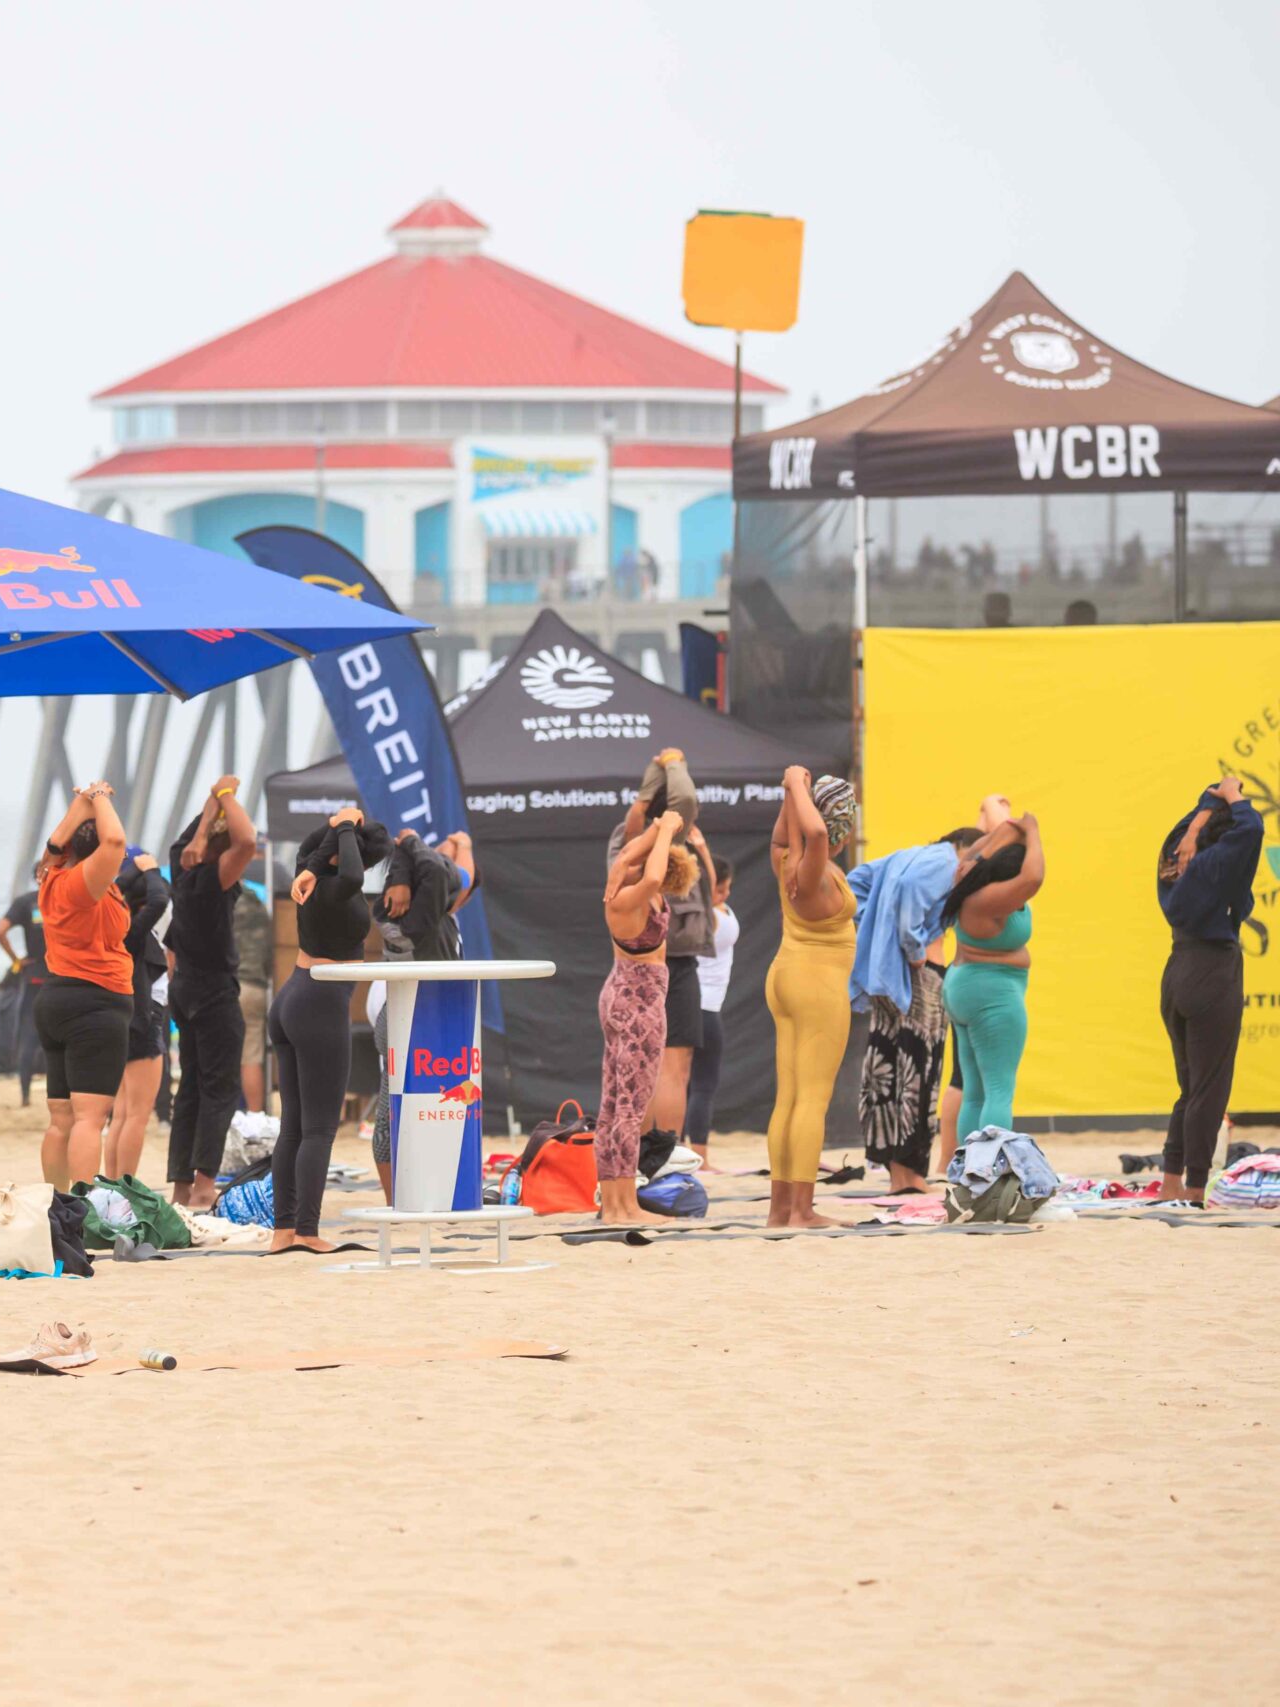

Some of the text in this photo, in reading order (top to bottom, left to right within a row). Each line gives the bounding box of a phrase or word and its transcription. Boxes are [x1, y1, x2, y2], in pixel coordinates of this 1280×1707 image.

[1013, 424, 1162, 480] WCBR
[521, 713, 651, 730] NEW EARTH
[534, 725, 651, 742] APPROVED
[528, 788, 618, 809] Solutions
[745, 784, 785, 801] Plan
[413, 1047, 468, 1077] Red
